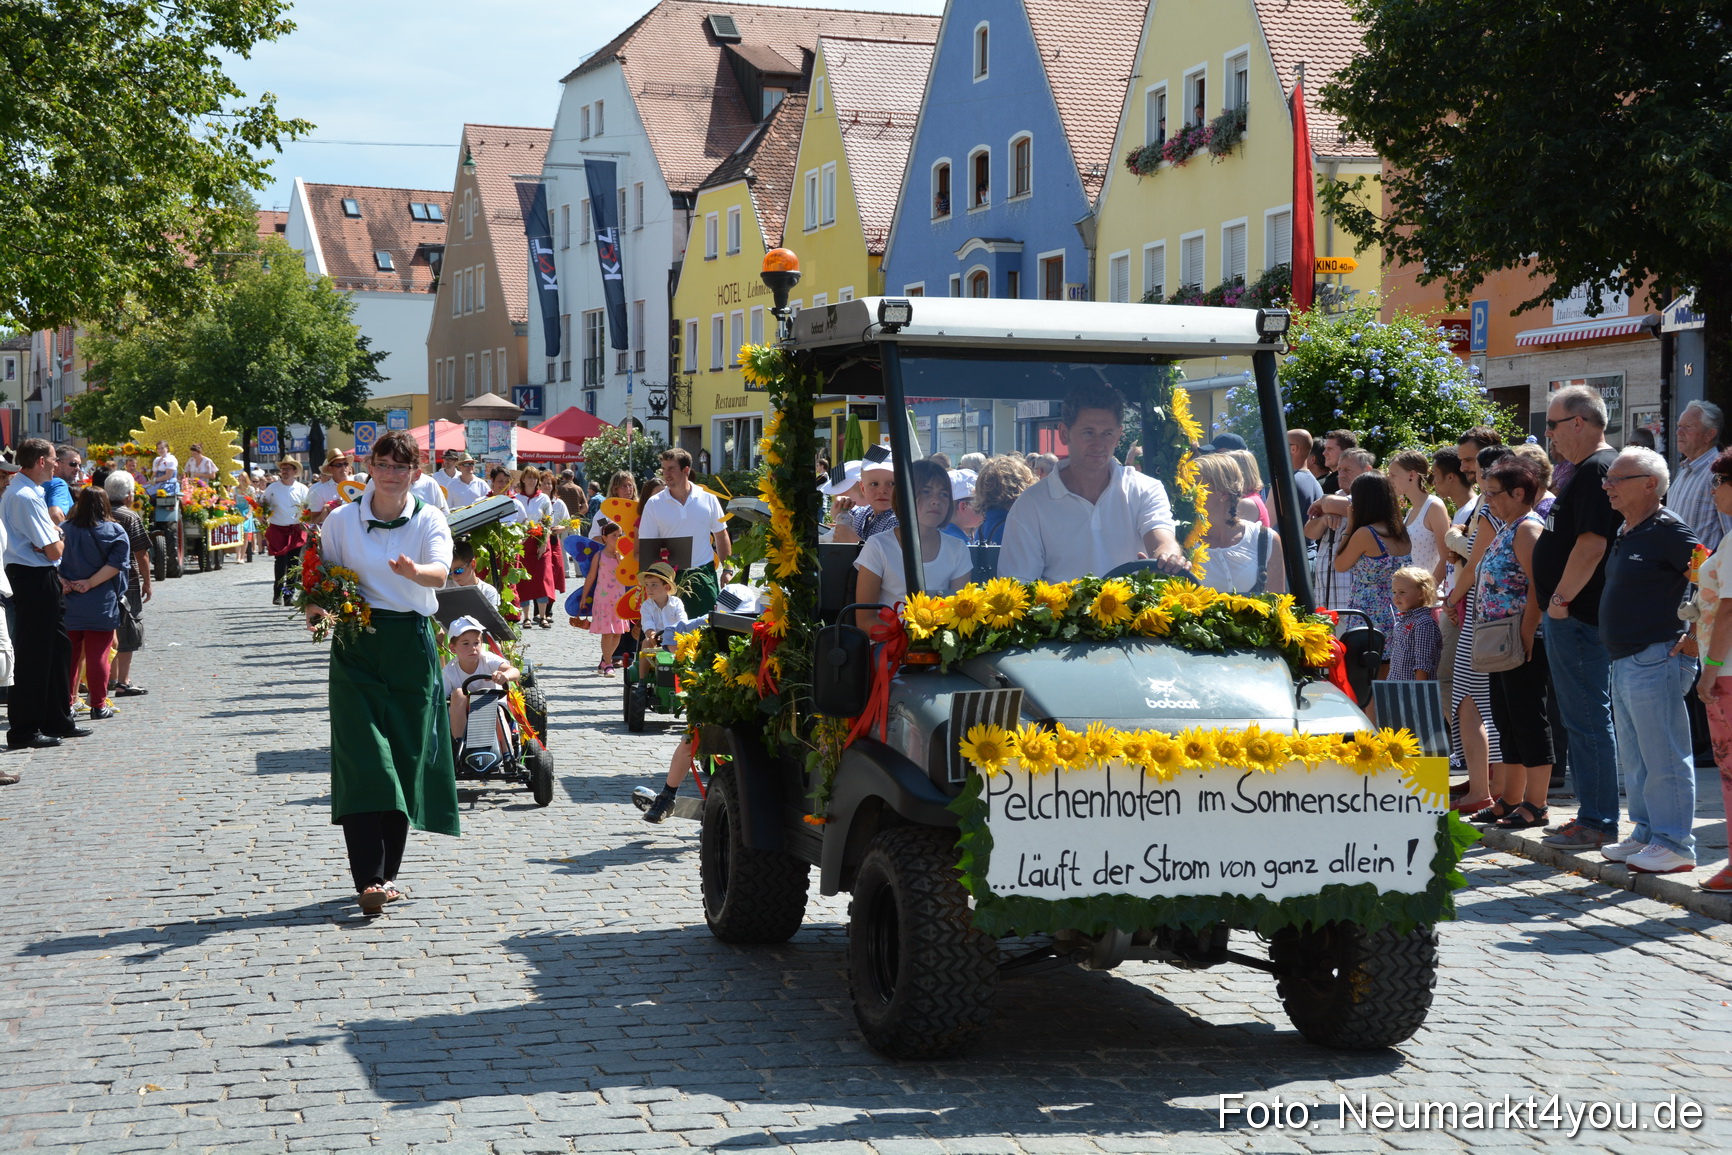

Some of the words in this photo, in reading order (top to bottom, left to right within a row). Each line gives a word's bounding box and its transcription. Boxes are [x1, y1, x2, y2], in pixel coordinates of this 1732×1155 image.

[598, 227, 621, 280] K&L
[1316, 260, 1338, 271] KINO
[717, 282, 741, 306] HOTEL
[1069, 285, 1085, 300] CAFÉ
[1684, 363, 1693, 376] 16
[715, 393, 748, 409] Restaurant
[1145, 697, 1201, 709] bobcat
[475, 756, 483, 766] 1
[986, 766, 1181, 821] Pelchenhofen
[1198, 773, 1226, 812] im
[1093, 851, 1135, 885] der
[1139, 843, 1210, 884] Strom
[1220, 859, 1256, 879] von
[1264, 857, 1319, 889] ganz
[1328, 842, 1395, 874] allein
